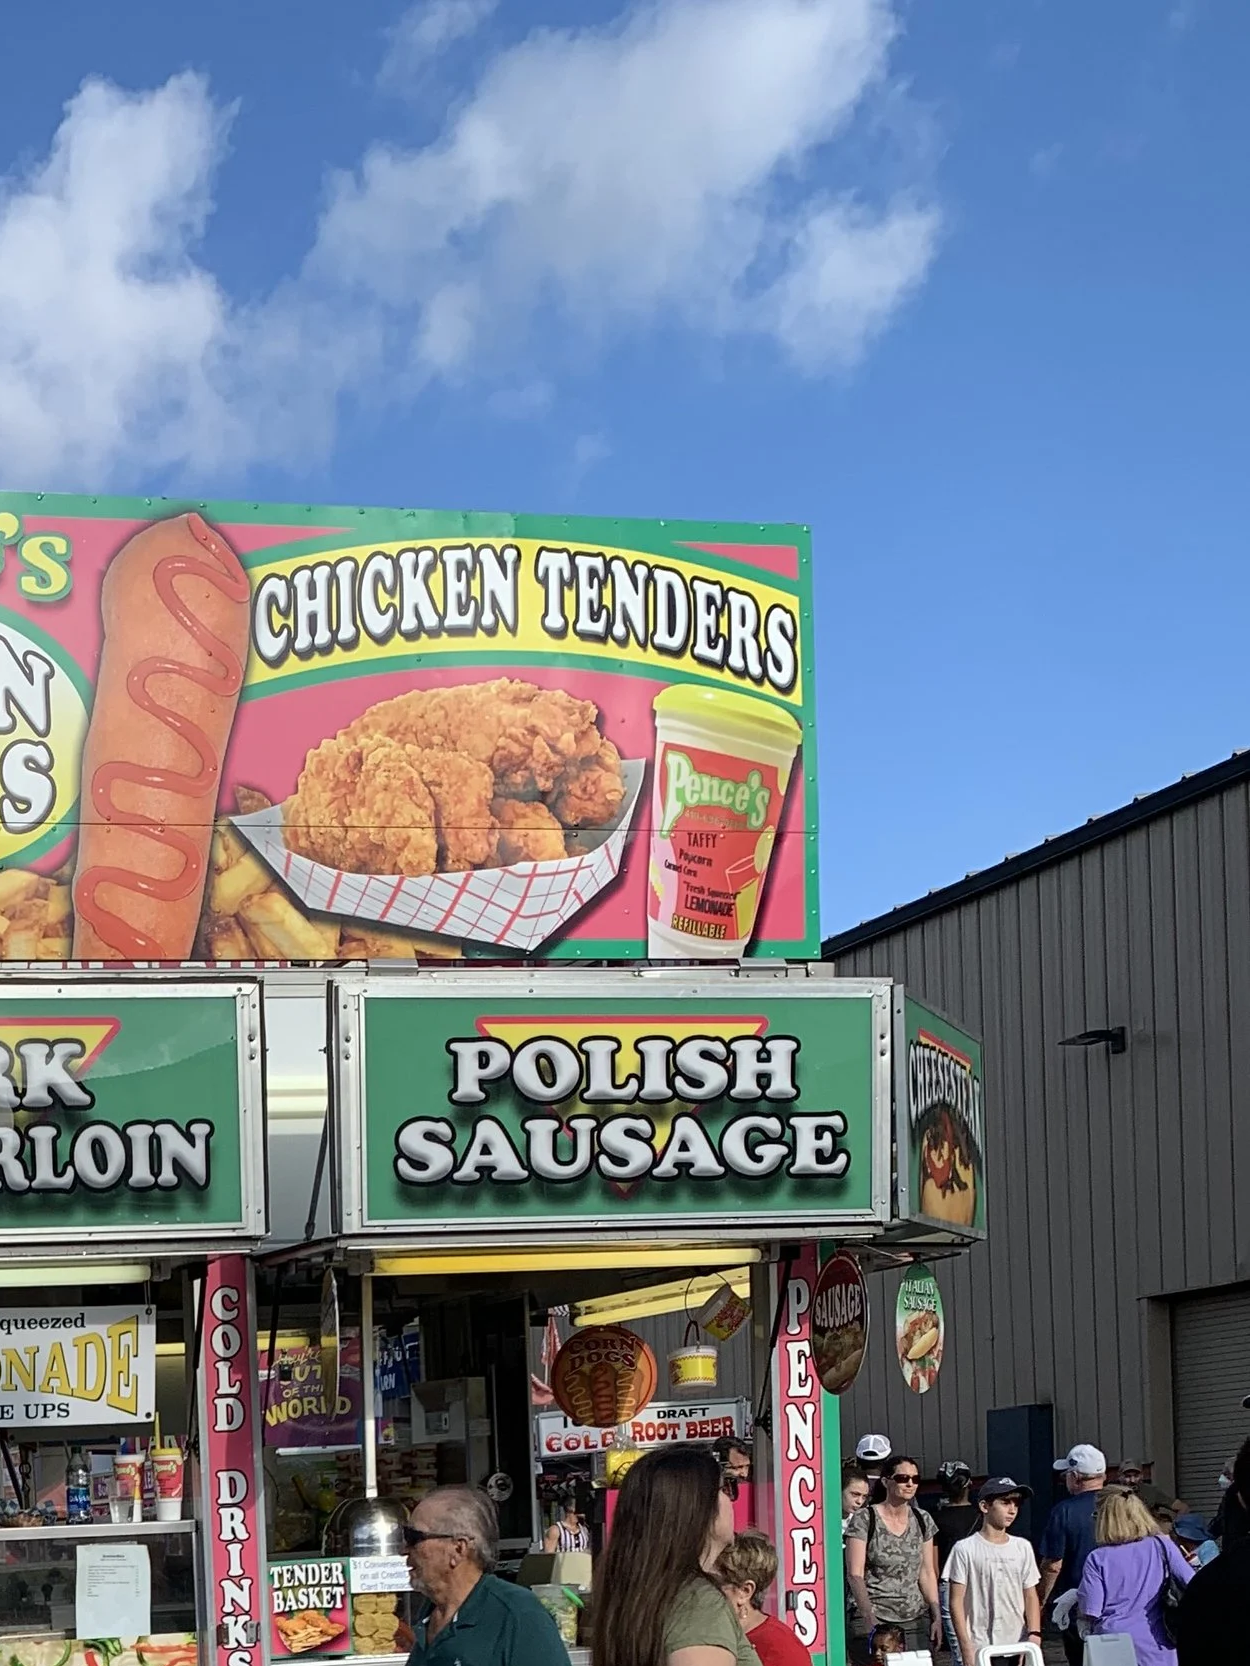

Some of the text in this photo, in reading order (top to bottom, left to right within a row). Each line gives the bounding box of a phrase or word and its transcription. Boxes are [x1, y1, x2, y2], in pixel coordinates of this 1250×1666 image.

[251, 543, 798, 696] CHICKEN TENDERS
[662, 750, 770, 839] Pence's
[687, 832, 717, 848] TAFFY
[685, 894, 734, 917] LEMONADE
[671, 913, 727, 939] REFILLABLE
[447, 1035, 800, 1105] POLISH
[394, 1110, 849, 1185] SAUSAGE
[905, 1280, 934, 1295] ITALIAN
[814, 1283, 863, 1325] SAUSAGE
[904, 1296, 937, 1312] SAUSAGE
[210, 1286, 244, 1432] COLD
[569, 1336, 637, 1356] CORN
[292, 1365, 322, 1381] UT
[570, 1350, 637, 1371] DOGS
[282, 1384, 324, 1398] OF TH
[24, 1402, 70, 1419] UPS
[656, 1407, 710, 1419] DRAFT
[631, 1421, 681, 1443] ROOT
[686, 1416, 735, 1439] BEER
[785, 1278, 819, 1648] PENCES
[270, 1562, 345, 1588] TENDER
[273, 1586, 345, 1614] BASKET
